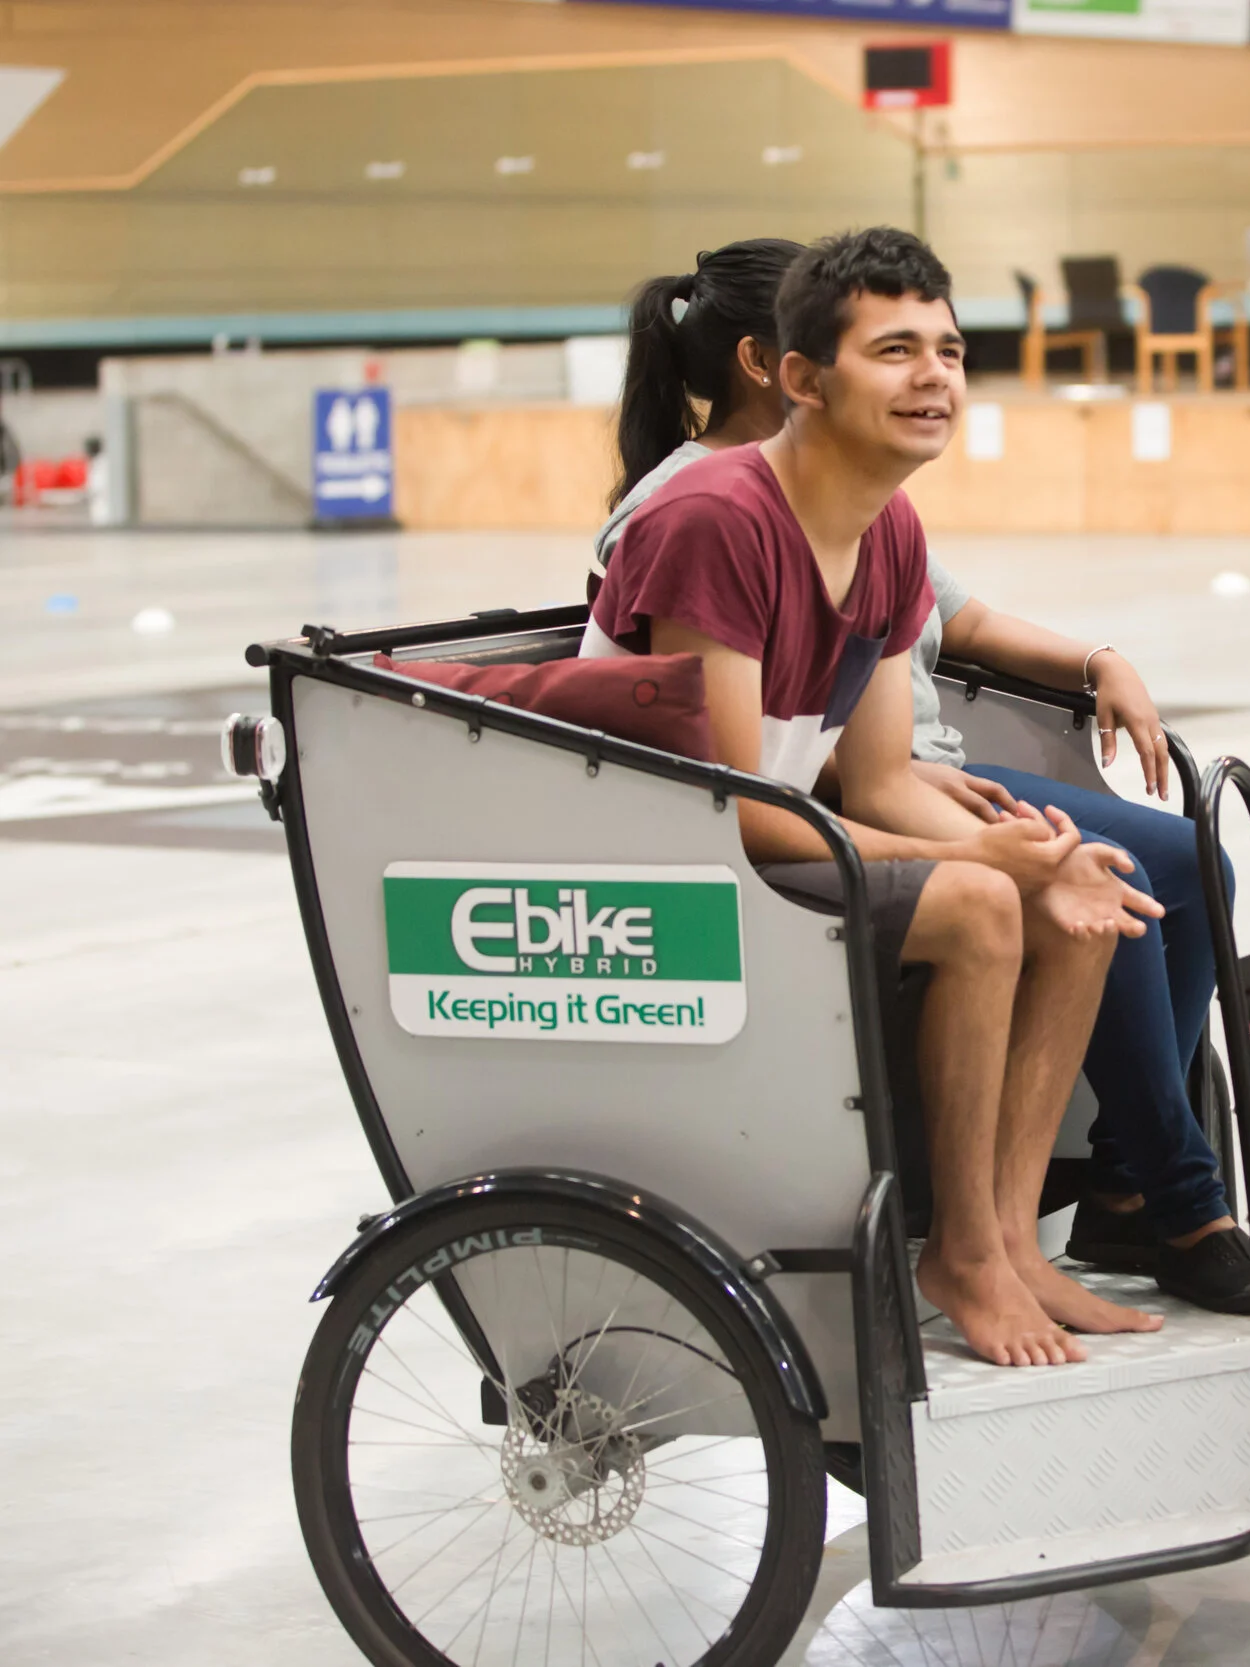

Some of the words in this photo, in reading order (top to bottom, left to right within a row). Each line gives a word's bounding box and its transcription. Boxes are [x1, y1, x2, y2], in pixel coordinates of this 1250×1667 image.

[451, 887, 655, 973] Ebike
[519, 957, 658, 976] HYBRID
[427, 990, 558, 1030] Keeping
[566, 993, 589, 1023] it
[595, 994, 706, 1027] Green!
[347, 1227, 542, 1356] PIMPLITE
